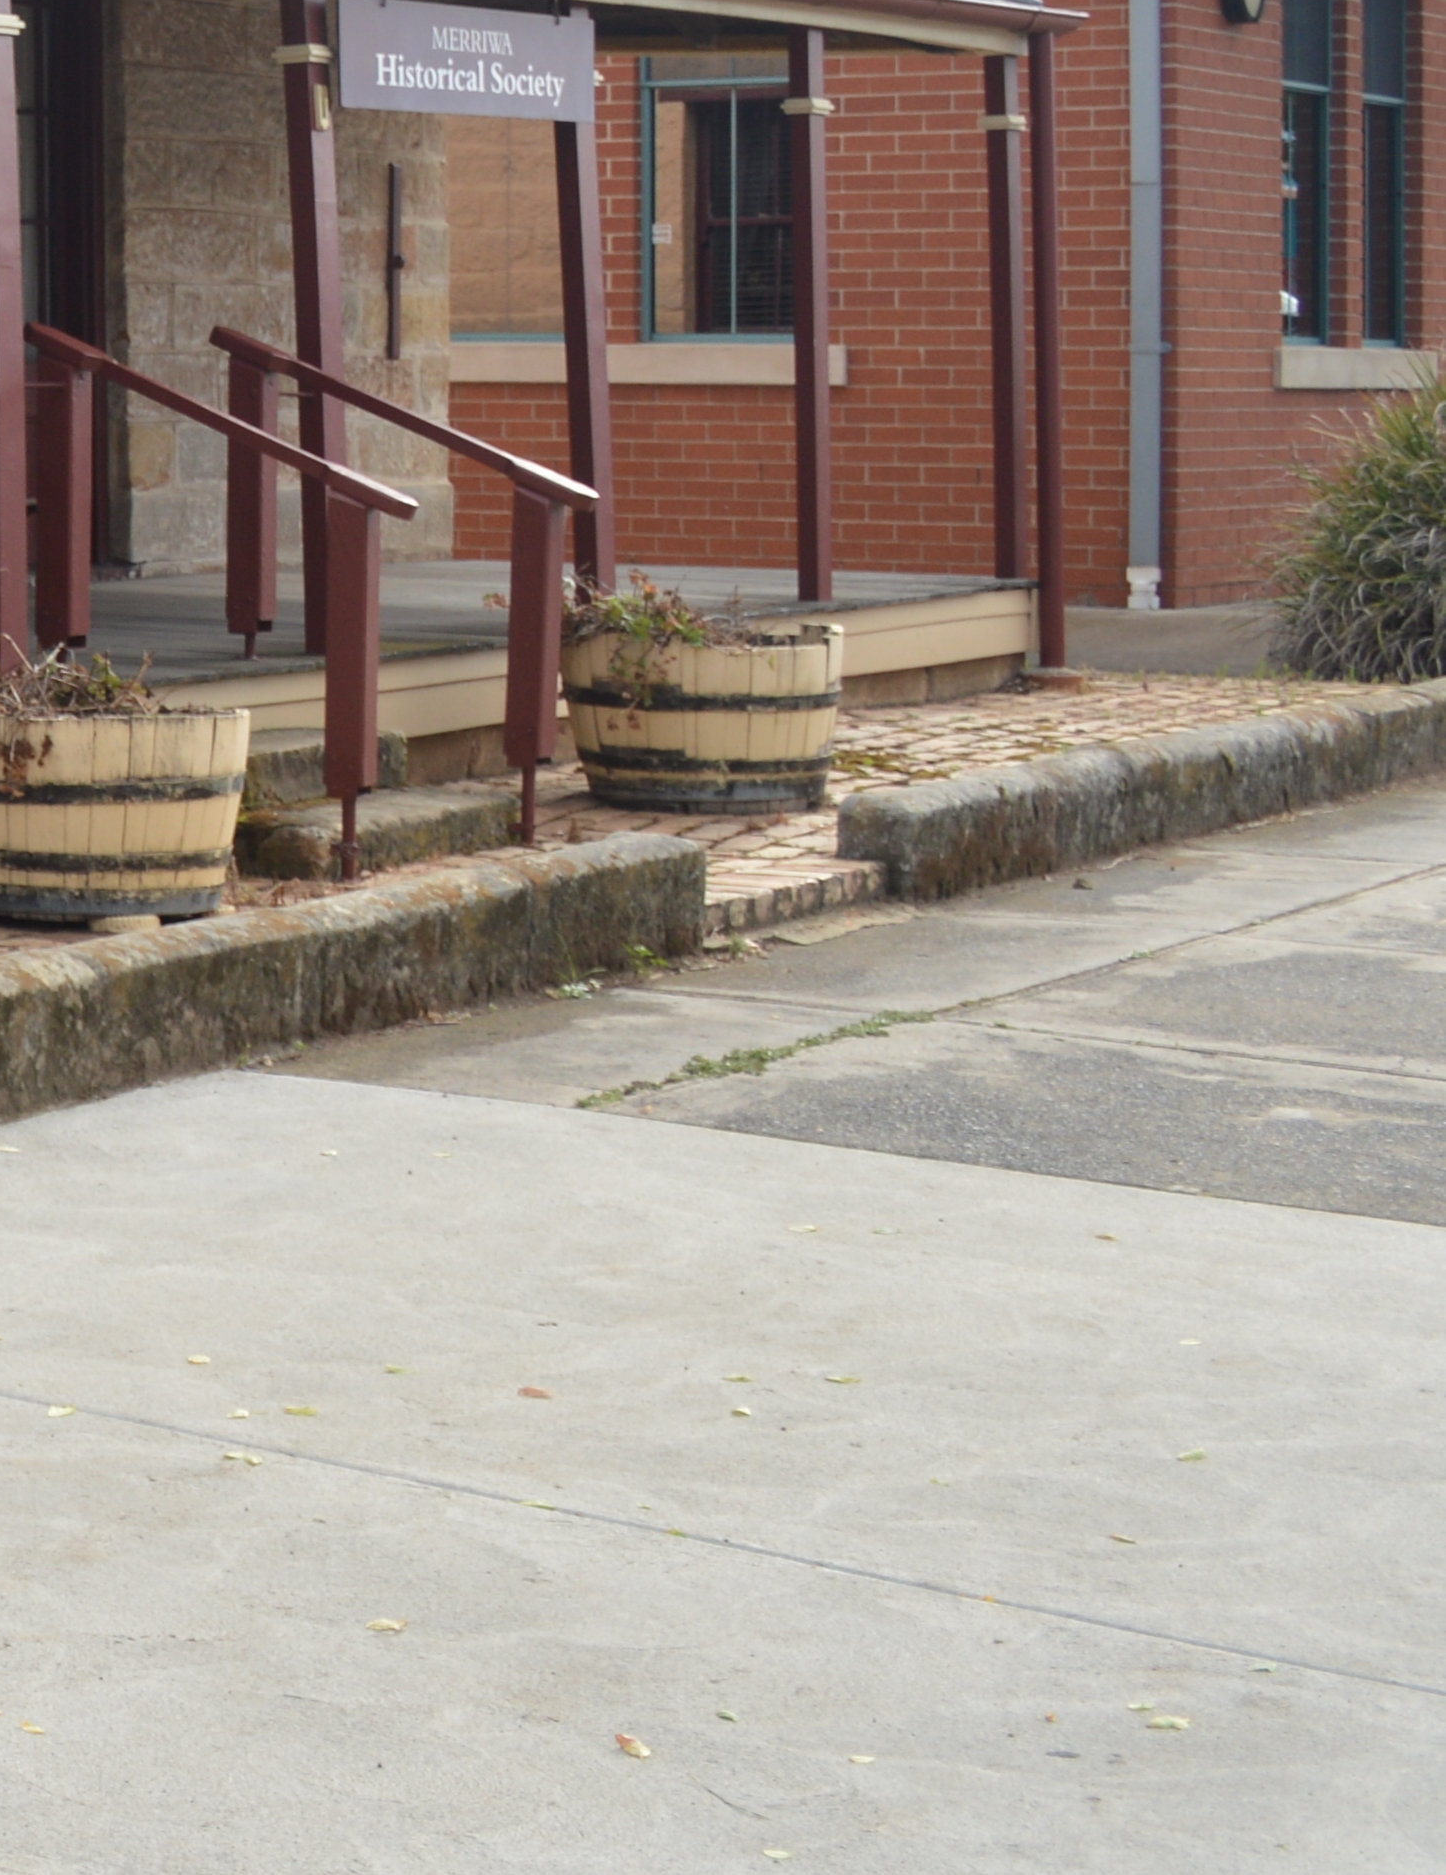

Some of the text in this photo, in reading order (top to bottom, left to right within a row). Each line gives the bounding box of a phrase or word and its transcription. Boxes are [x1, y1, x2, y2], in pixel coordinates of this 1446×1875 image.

[431, 26, 514, 56] MERRIWA
[375, 53, 565, 107] Historical Society
